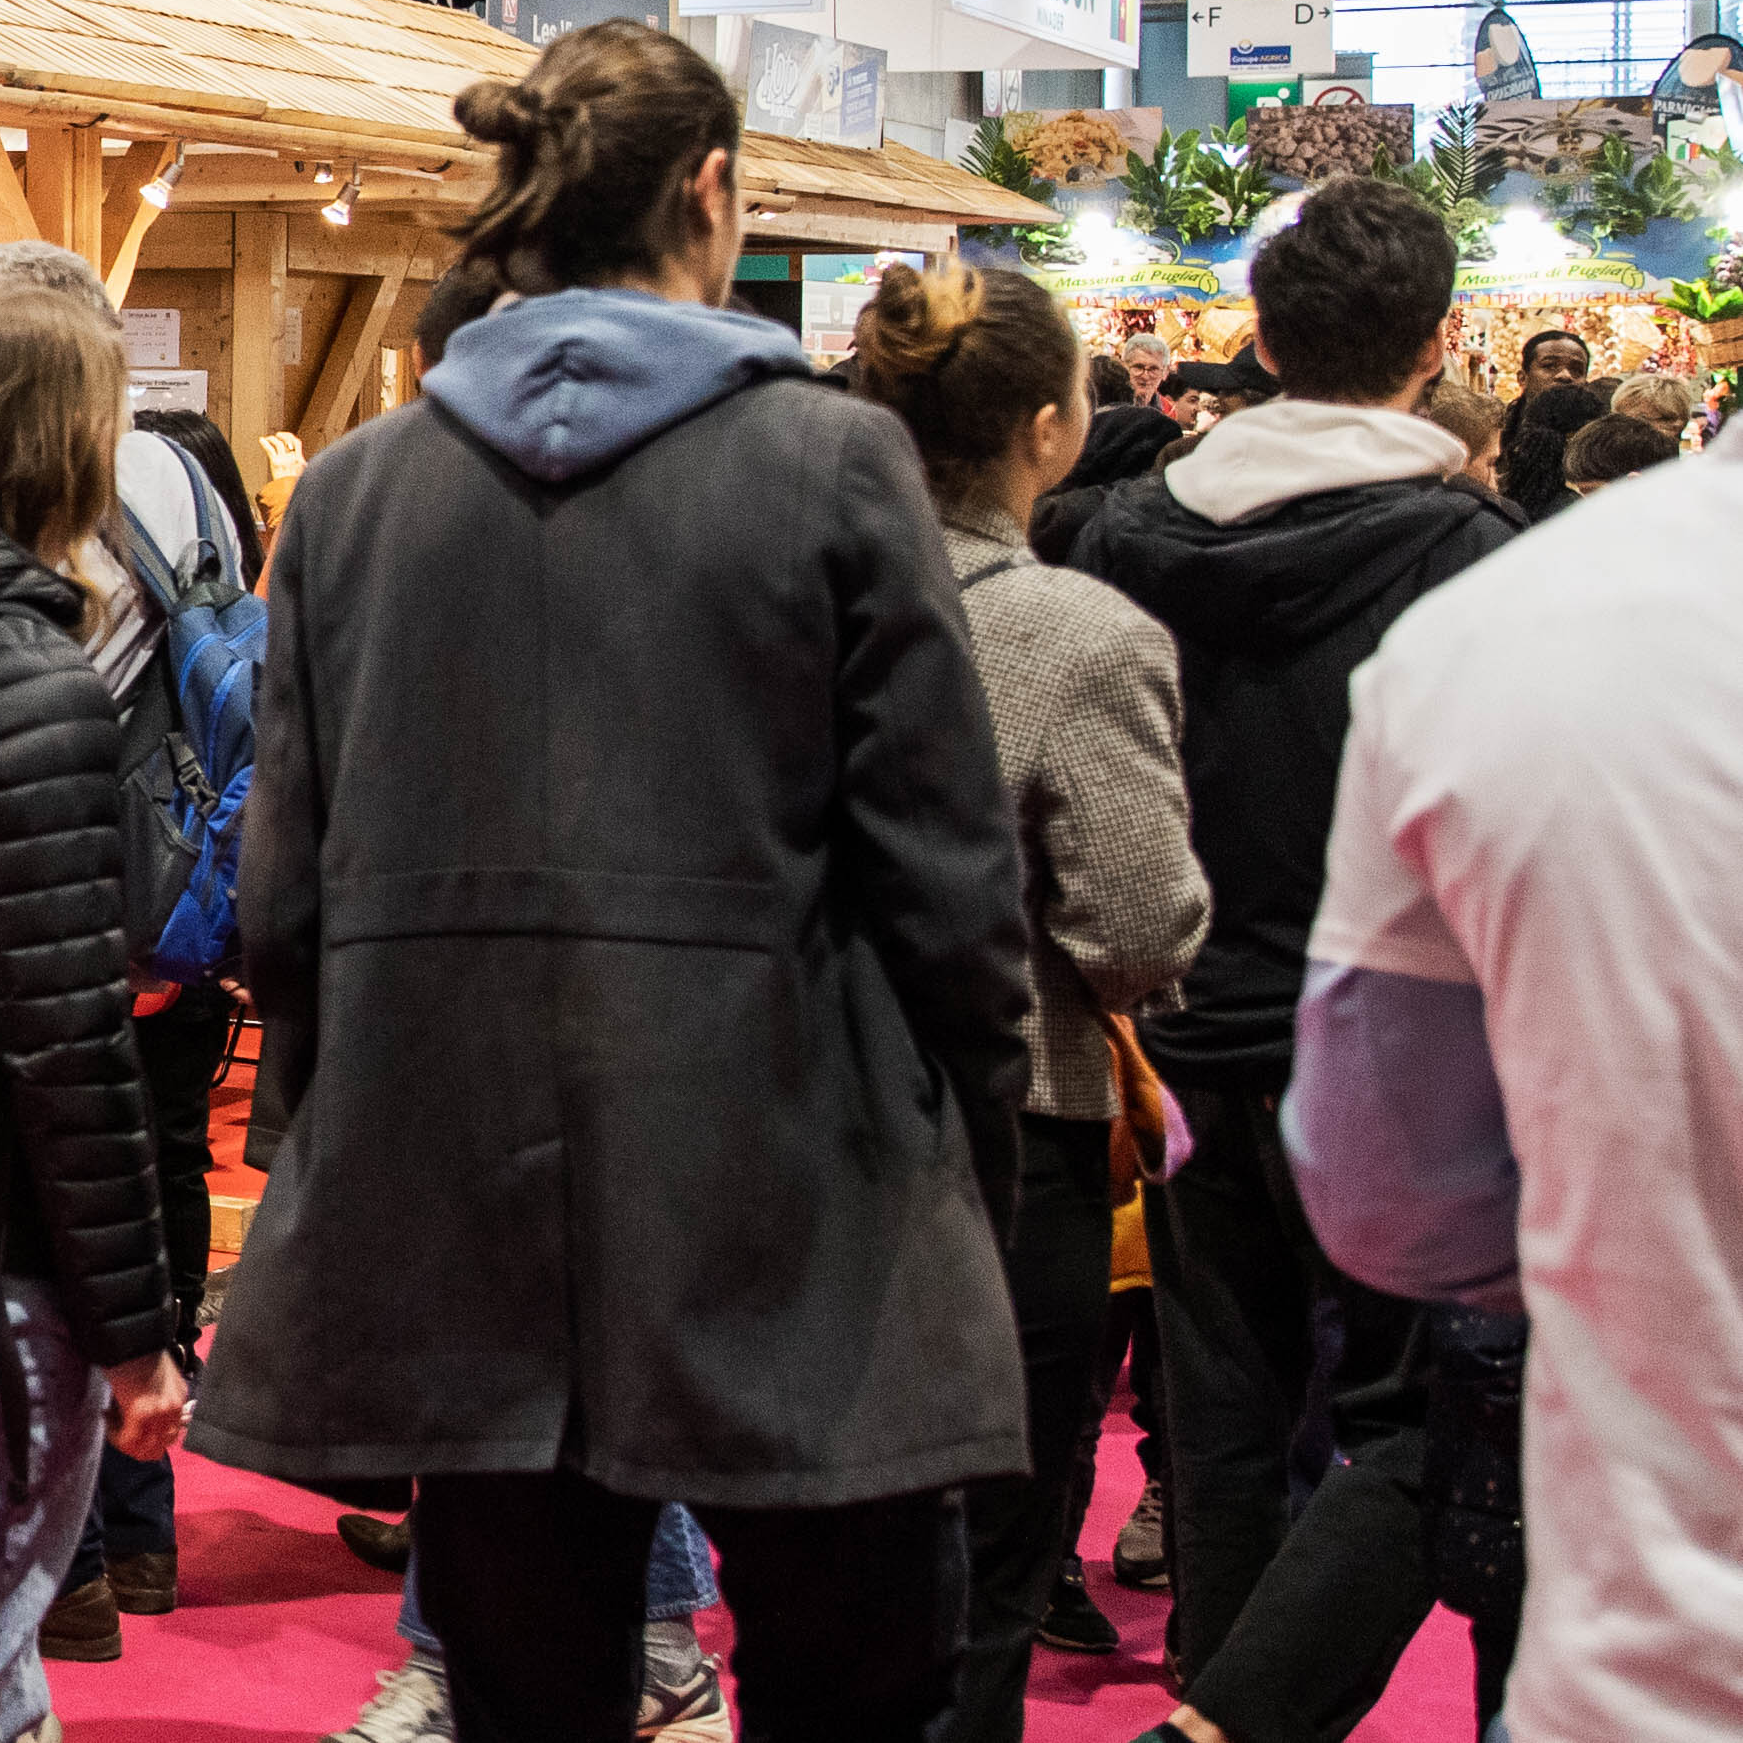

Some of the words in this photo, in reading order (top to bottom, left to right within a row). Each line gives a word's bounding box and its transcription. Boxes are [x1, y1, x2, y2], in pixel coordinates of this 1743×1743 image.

[1208, 7, 1223, 28] F
[1294, 4, 1314, 25] D
[1130, 271, 1144, 282] di
